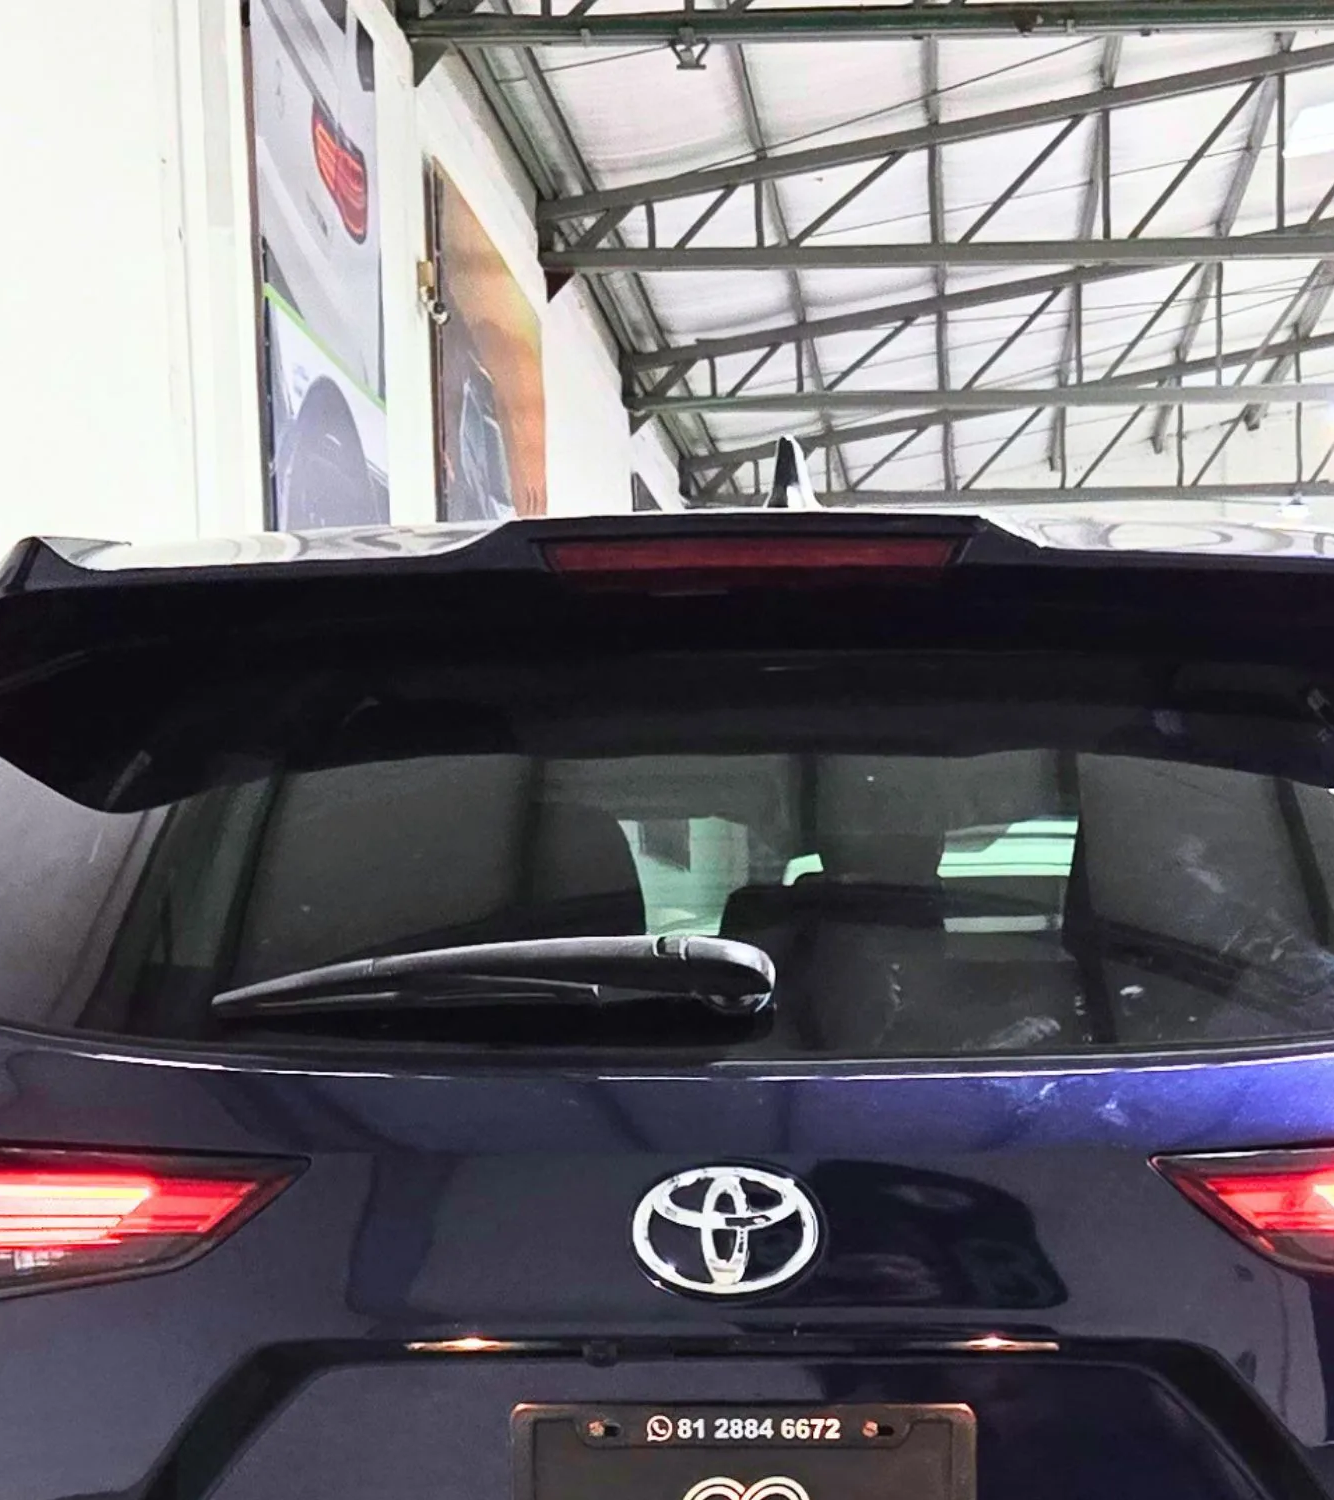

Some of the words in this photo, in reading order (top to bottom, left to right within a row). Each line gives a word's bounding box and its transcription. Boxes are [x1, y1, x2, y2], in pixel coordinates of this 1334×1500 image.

[677, 1418, 705, 1439] 81
[714, 1418, 774, 1439] 2884
[780, 1418, 841, 1440] 6672
